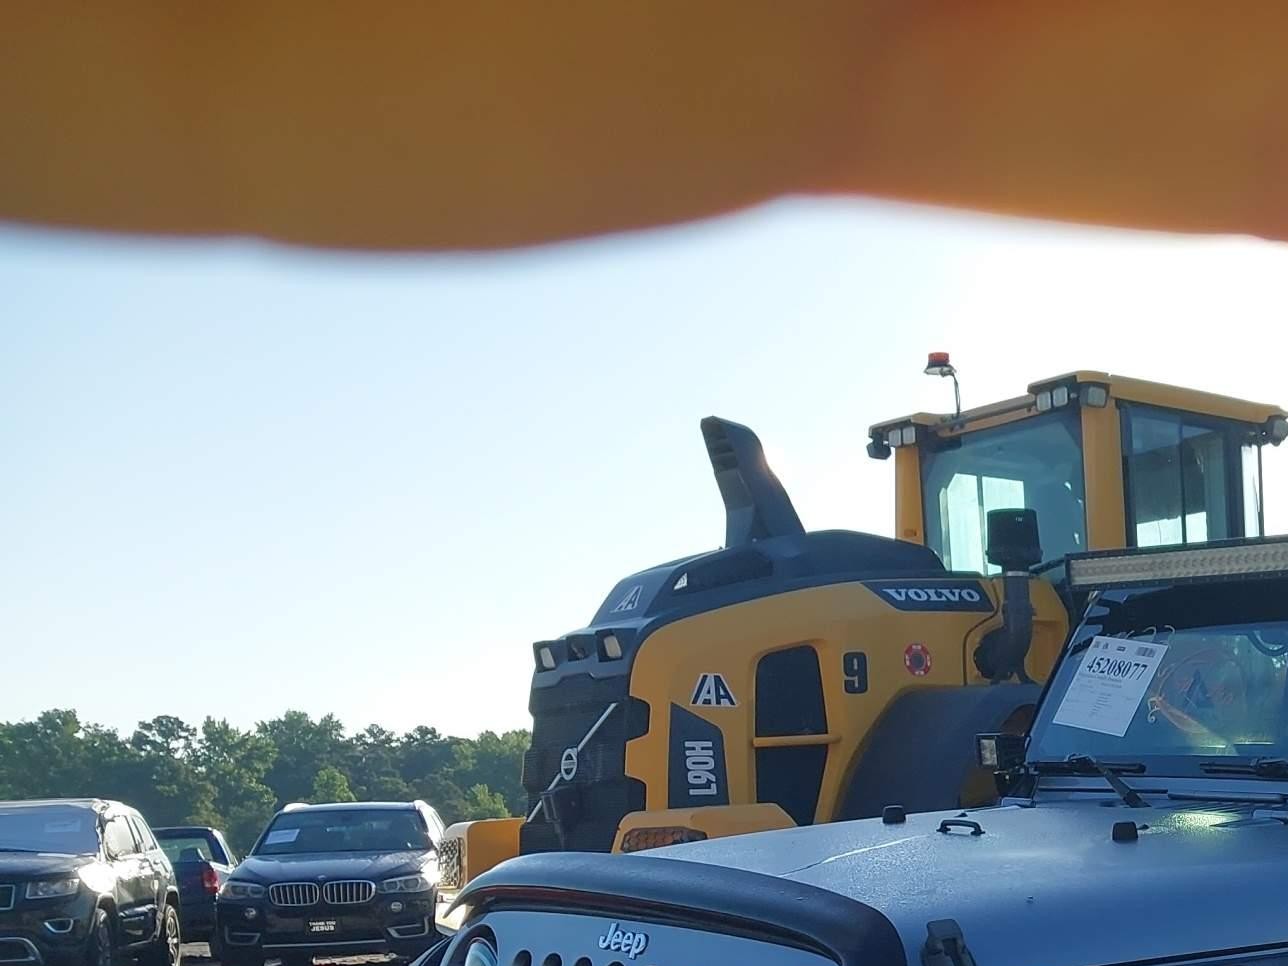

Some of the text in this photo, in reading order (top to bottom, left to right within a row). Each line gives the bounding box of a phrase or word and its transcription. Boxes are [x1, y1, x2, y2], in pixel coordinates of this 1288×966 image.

[882, 588, 980, 602] VOLVO
[843, 651, 869, 694] 9
[1086, 656, 1149, 681] 45208077
[684, 741, 718, 796] L90H
[599, 922, 648, 960] Jeep
